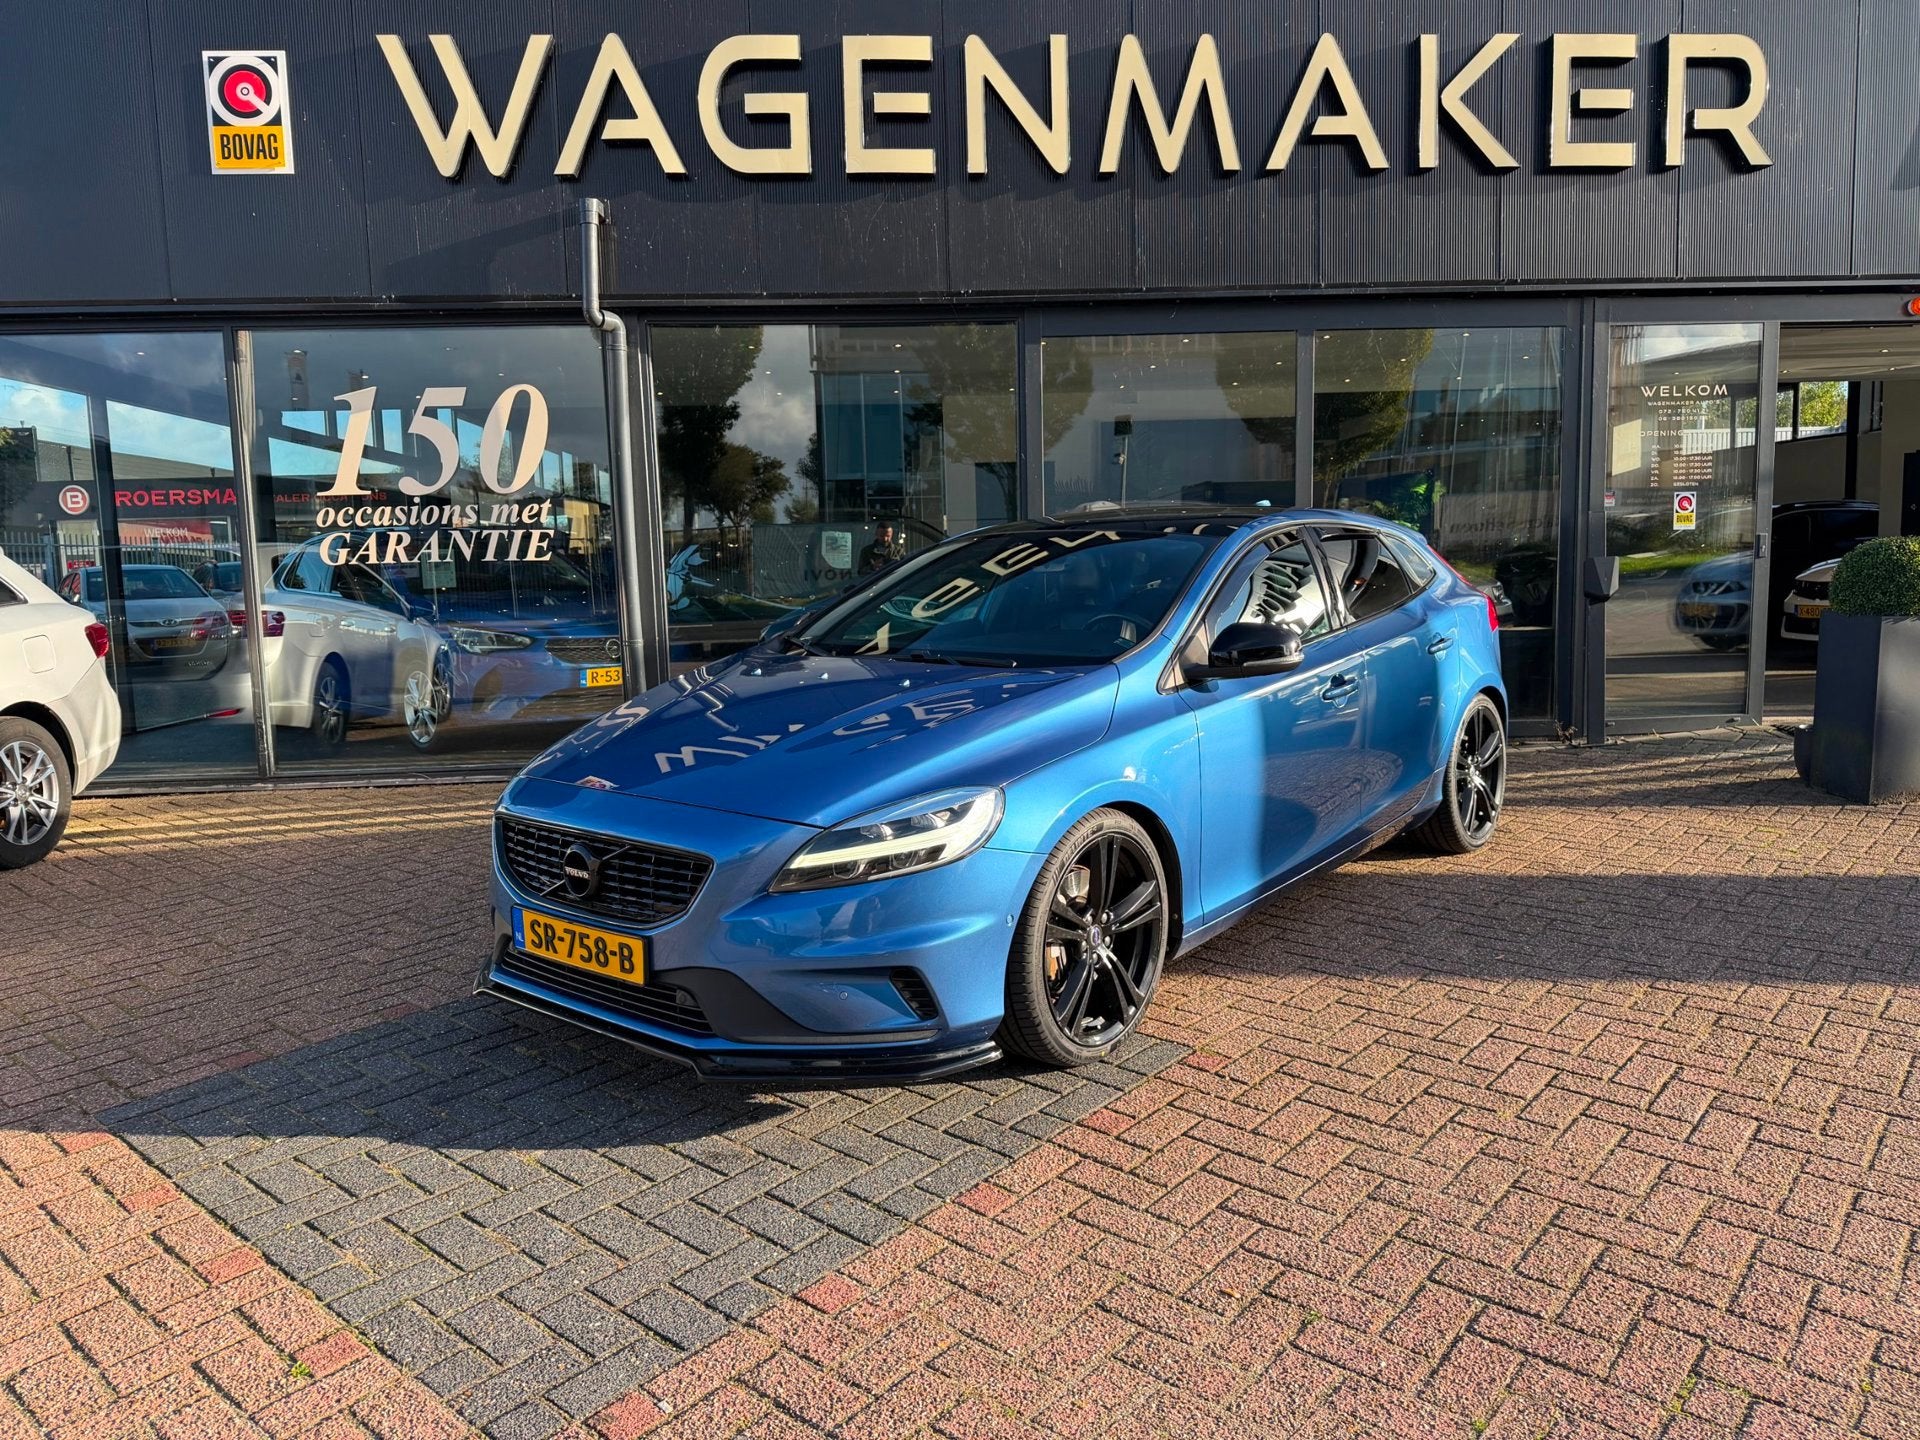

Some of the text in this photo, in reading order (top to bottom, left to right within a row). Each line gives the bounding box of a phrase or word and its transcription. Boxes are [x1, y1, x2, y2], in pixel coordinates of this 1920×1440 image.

[376, 32, 1774, 178] WAGENMAKER
[220, 133, 278, 160] BOVAG
[1640, 384, 1728, 397] WELKOM
[316, 383, 549, 496] 150
[66, 491, 84, 508] B
[115, 487, 237, 507] ROERSMA
[274, 493, 310, 503] ALER
[316, 497, 552, 528] occasions met
[143, 527, 189, 538] WELKOM
[319, 529, 556, 566] GARANTIE
[1800, 606, 1819, 617] X-480
[591, 669, 621, 684] R-53
[565, 866, 589, 879] VOLVO
[530, 919, 635, 975] SR-758-B
